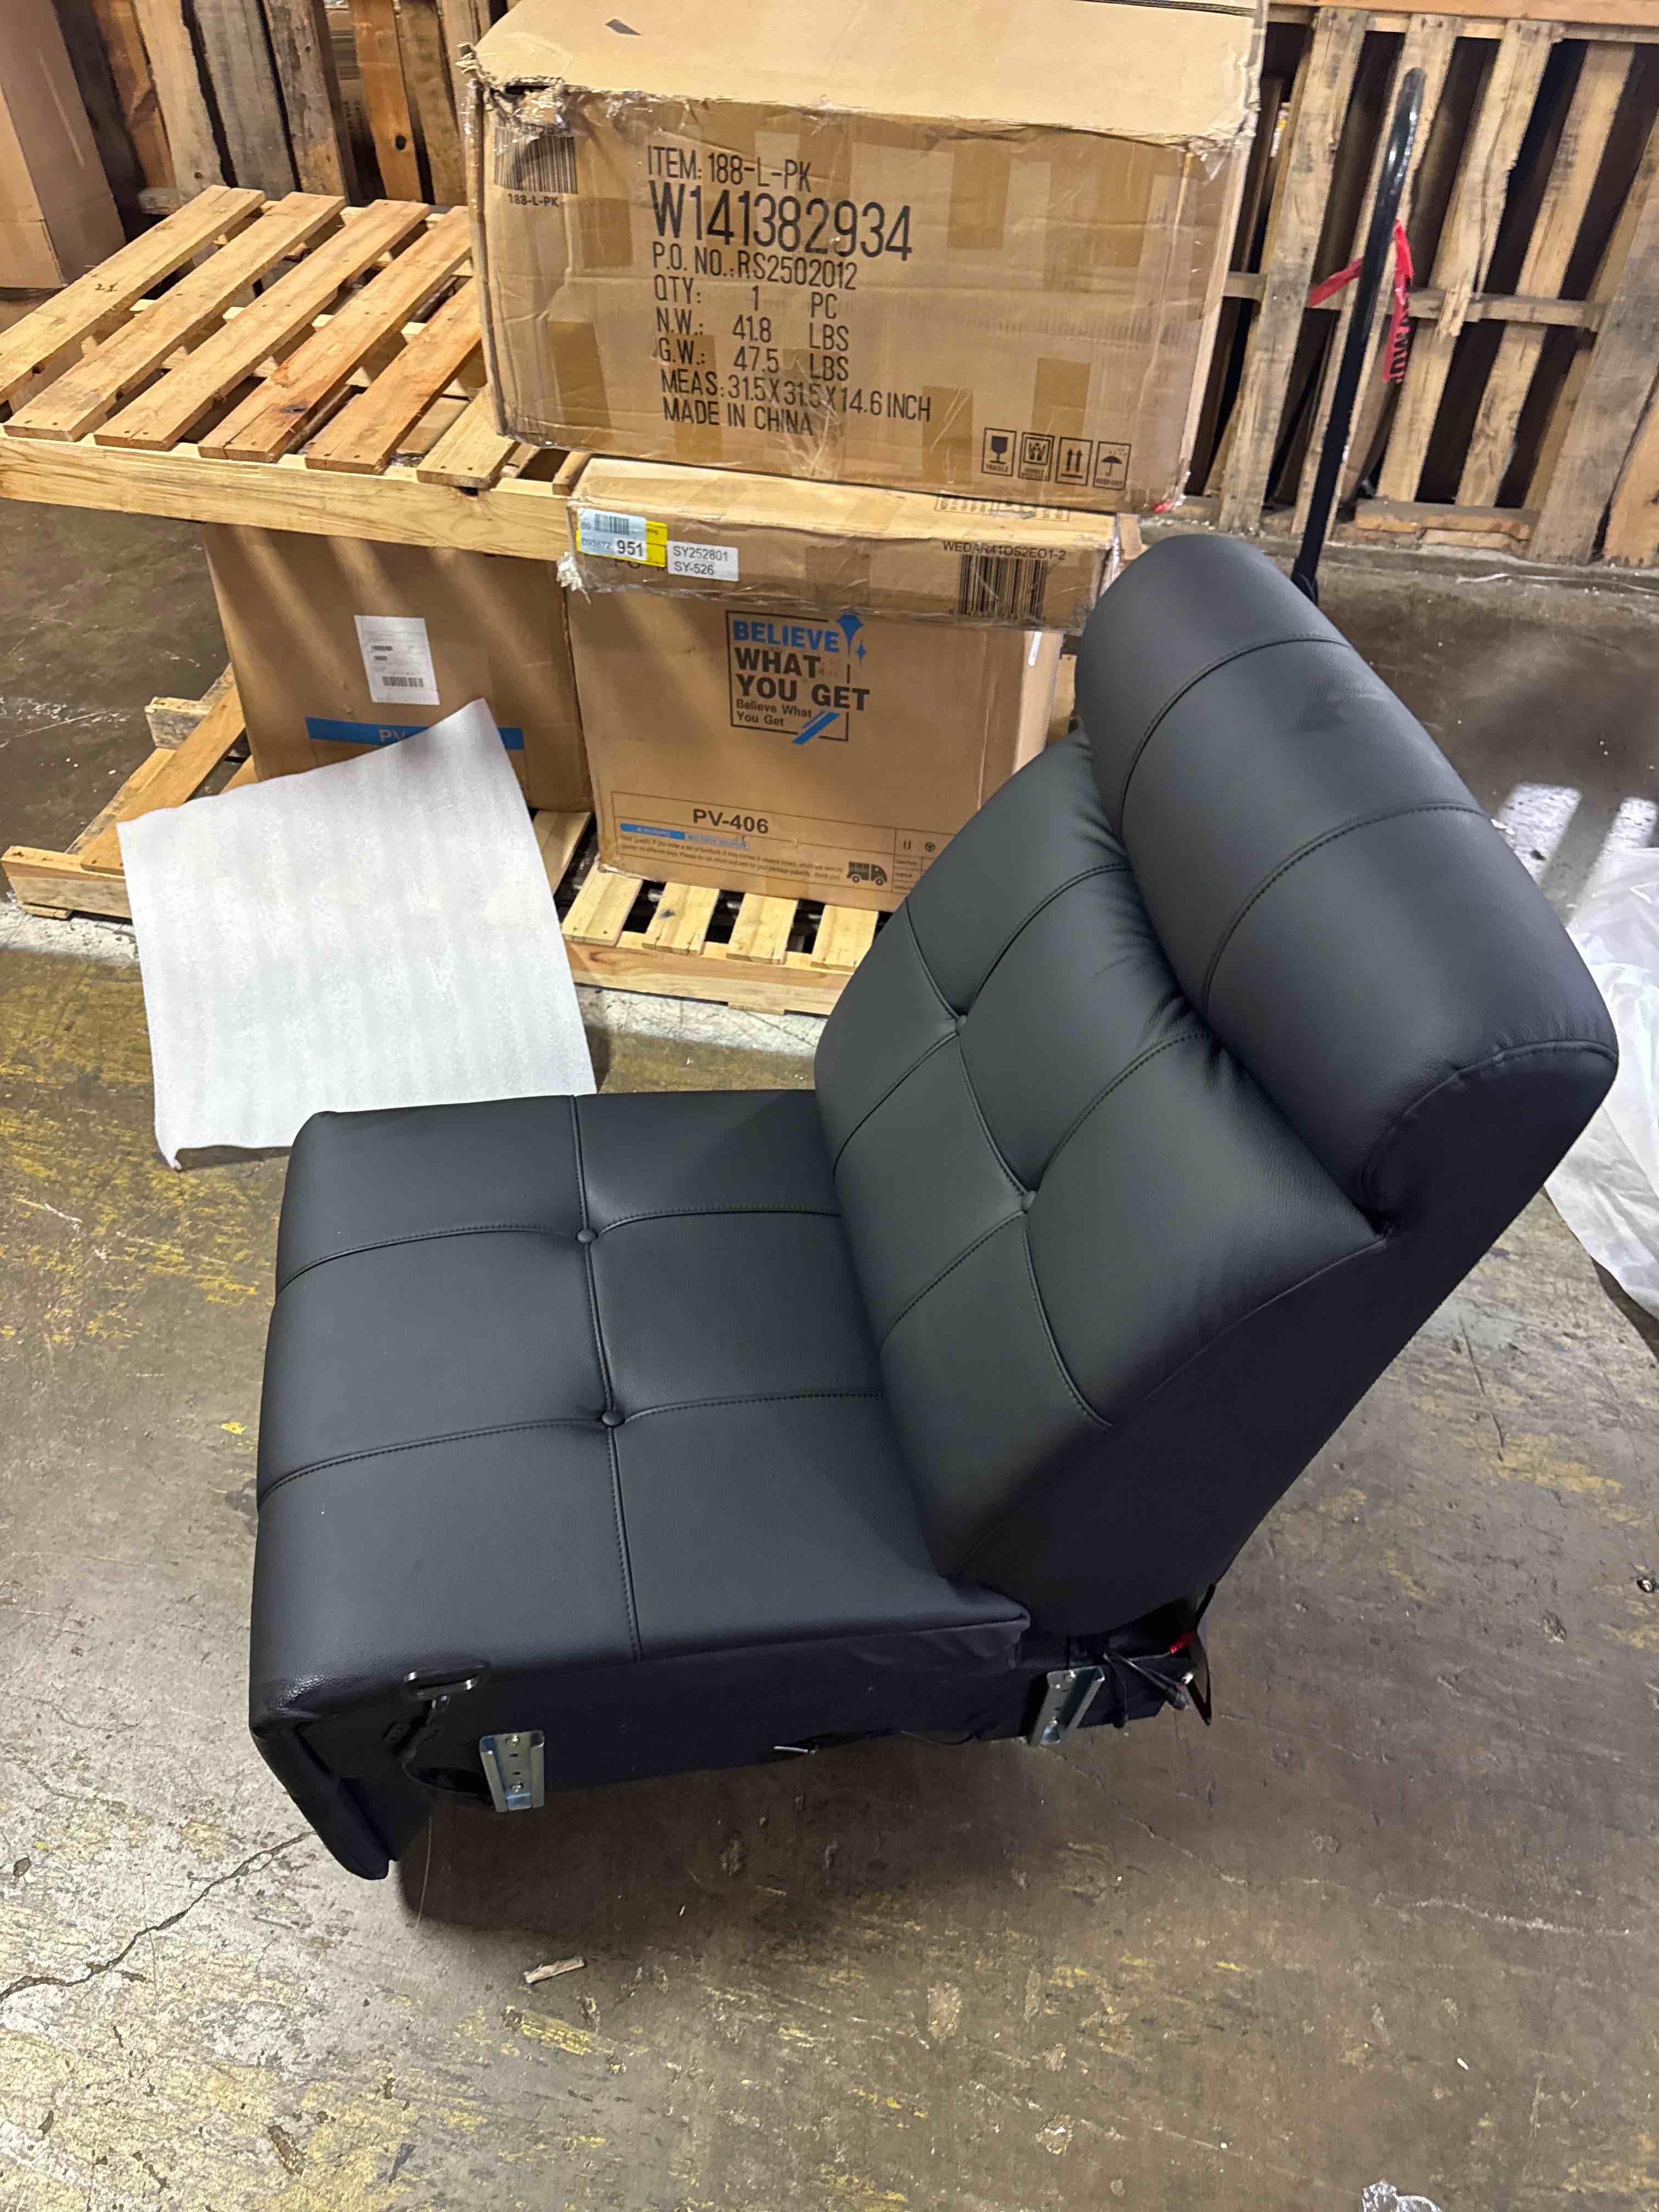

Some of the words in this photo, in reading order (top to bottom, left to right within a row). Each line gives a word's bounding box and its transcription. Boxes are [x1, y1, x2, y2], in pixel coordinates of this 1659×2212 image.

[648, 145, 702, 180] ITEM:
[709, 152, 811, 193] 188-L-PK
[507, 193, 560, 207] 188-L-PK
[648, 179, 912, 262] W141382934
[652, 241, 688, 271] P.O.
[737, 250, 858, 290] RS2502012
[654, 274, 702, 304] QTY:
[752, 284, 759, 312] 1
[810, 291, 838, 320] PC
[656, 306, 703, 336] N.W.:
[732, 314, 772, 343] 41.8
[809, 322, 849, 352] LBS
[658, 337, 706, 365] G.W.:
[733, 345, 780, 374] 47.5
[809, 353, 849, 382] LBS
[662, 396, 720, 426] MADE
[726, 402, 746, 428] IN
[754, 405, 814, 437] CHINA
[616, 539, 644, 557] 951
[673, 545, 729, 562] SY252801
[674, 561, 715, 575] SY-526
[733, 619, 840, 653] BELIEVE
[734, 647, 821, 679] WHAT
[736, 673, 797, 702] YOU
[811, 684, 870, 712] GET
[736, 698, 777, 713] Believe
[781, 704, 812, 718] What
[737, 711, 759, 723] You
[764, 715, 785, 726] Get
[692, 808, 769, 834] PV-406
